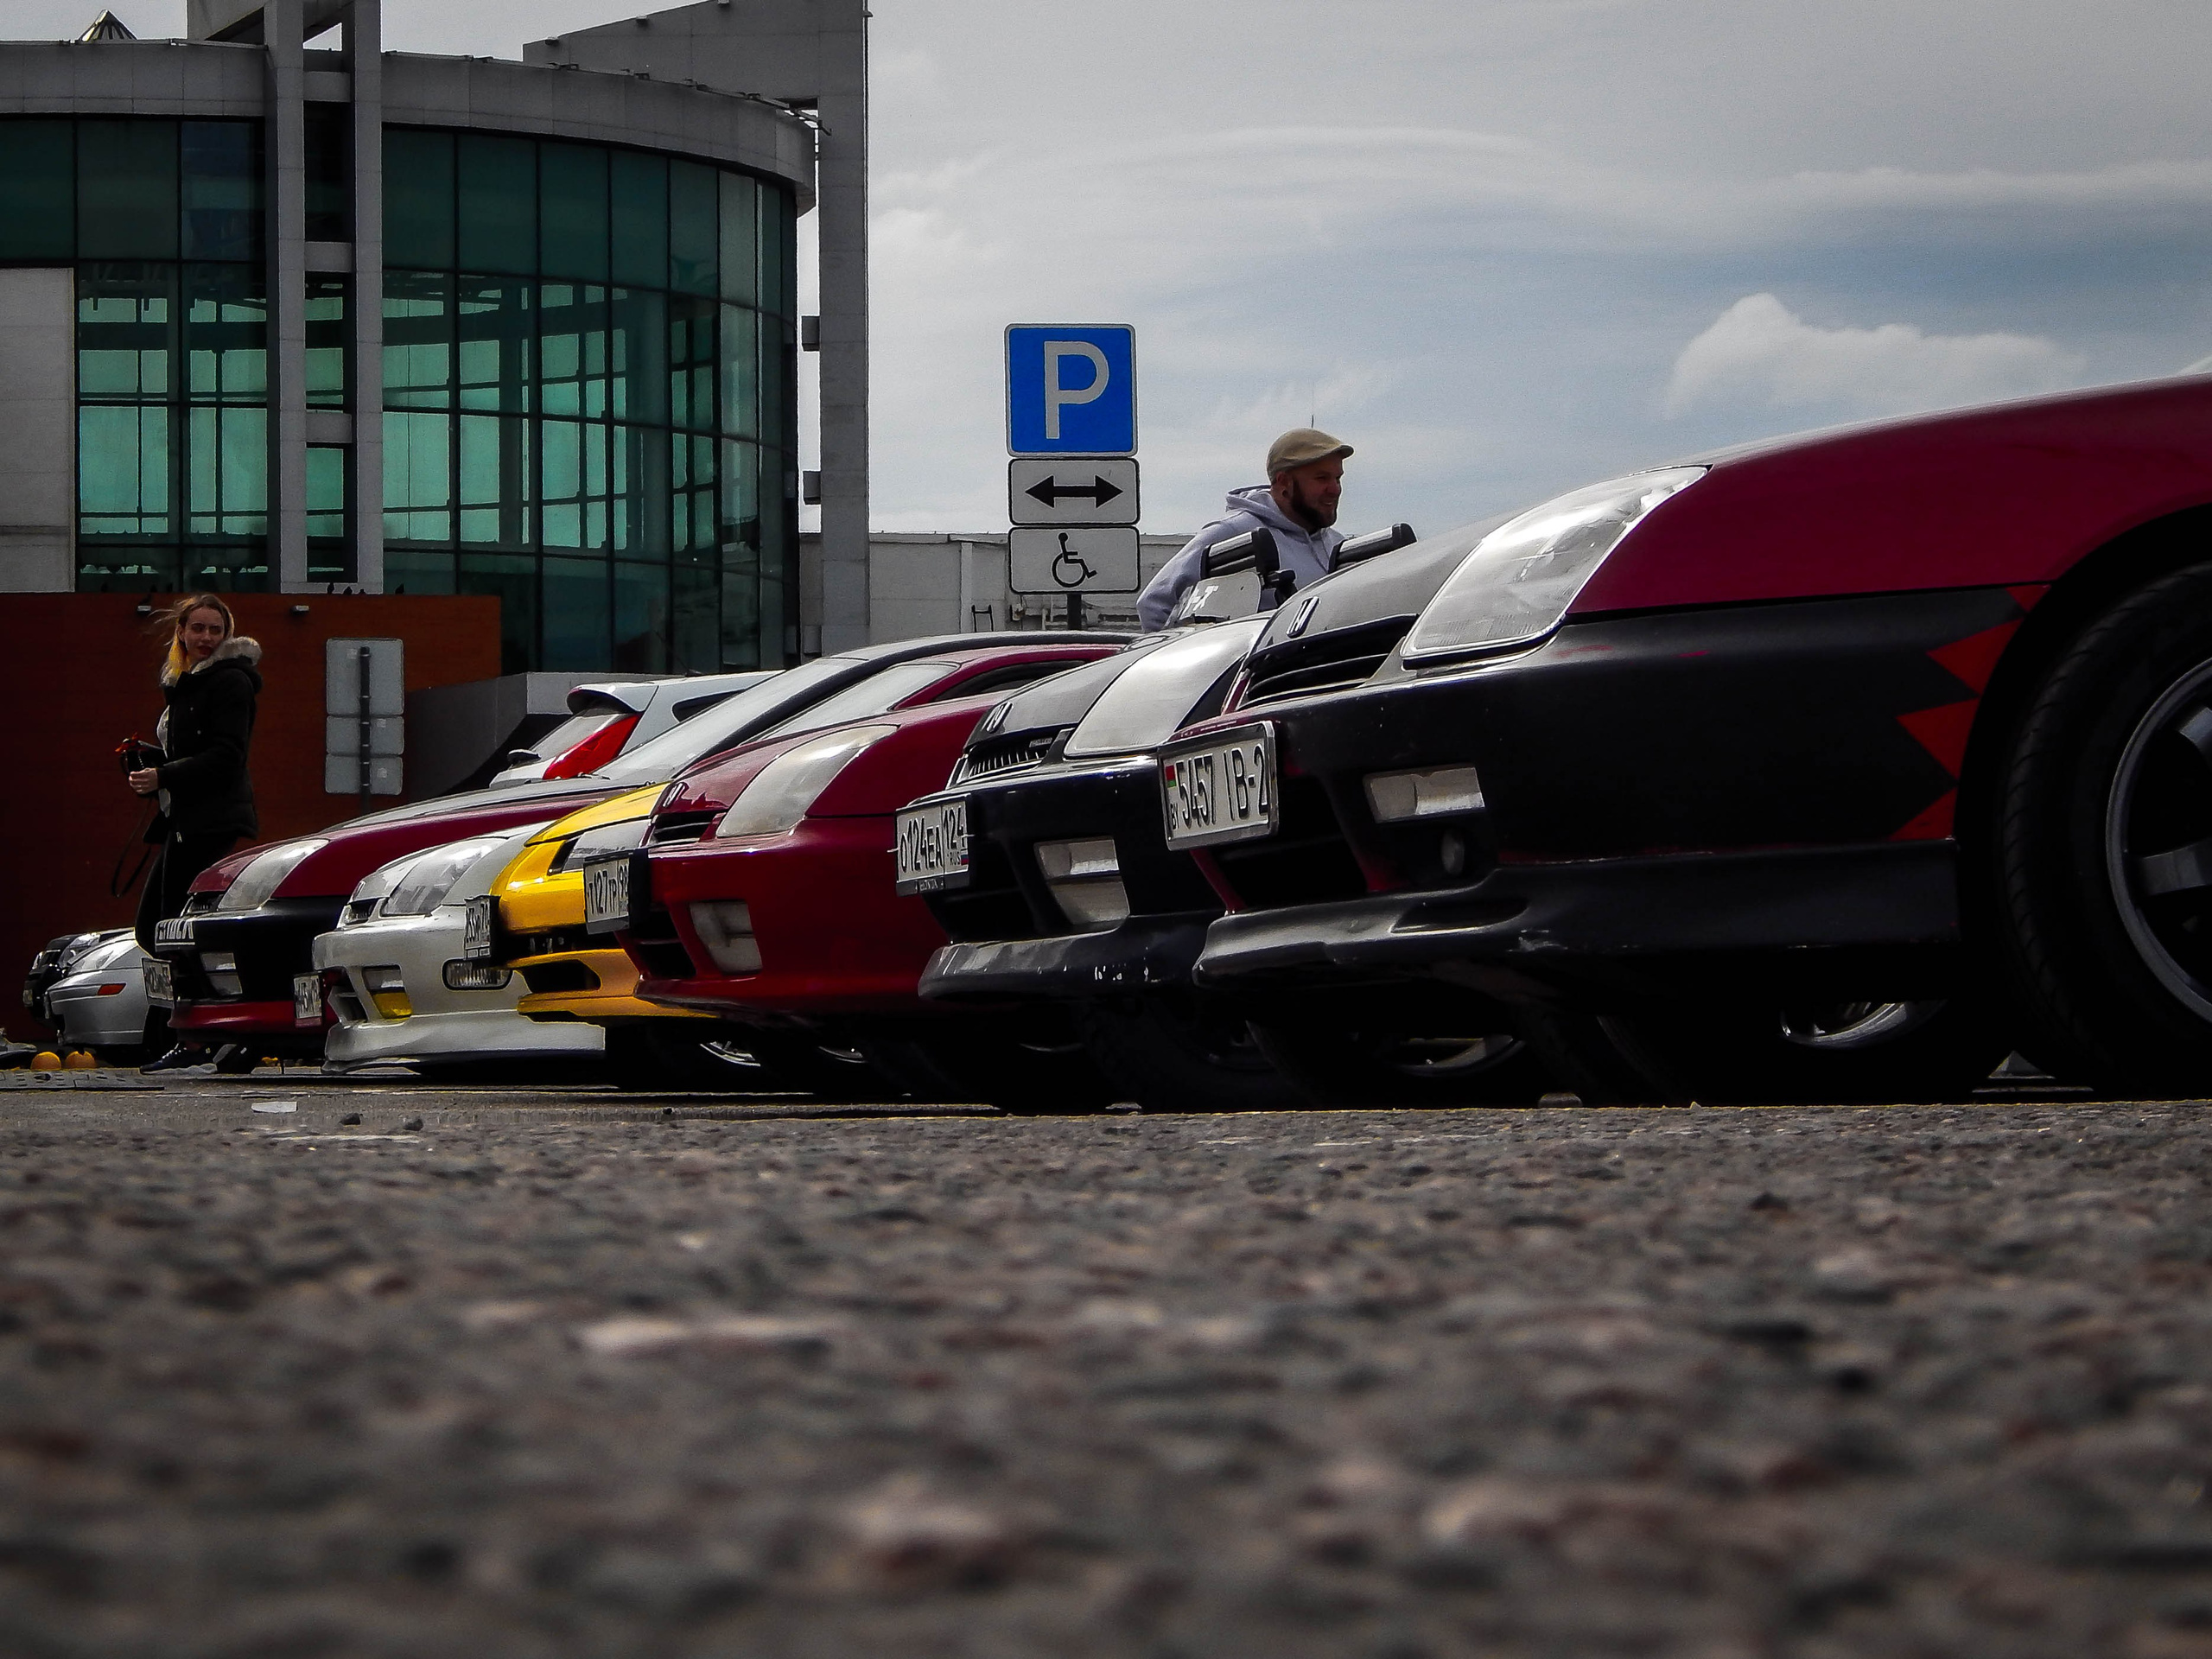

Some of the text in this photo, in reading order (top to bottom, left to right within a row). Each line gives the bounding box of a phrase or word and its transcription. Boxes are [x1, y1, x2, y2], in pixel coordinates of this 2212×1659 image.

[1044, 340, 1109, 439] P
[943, 805, 966, 850] 124
[1175, 753, 1217, 830] 5457
